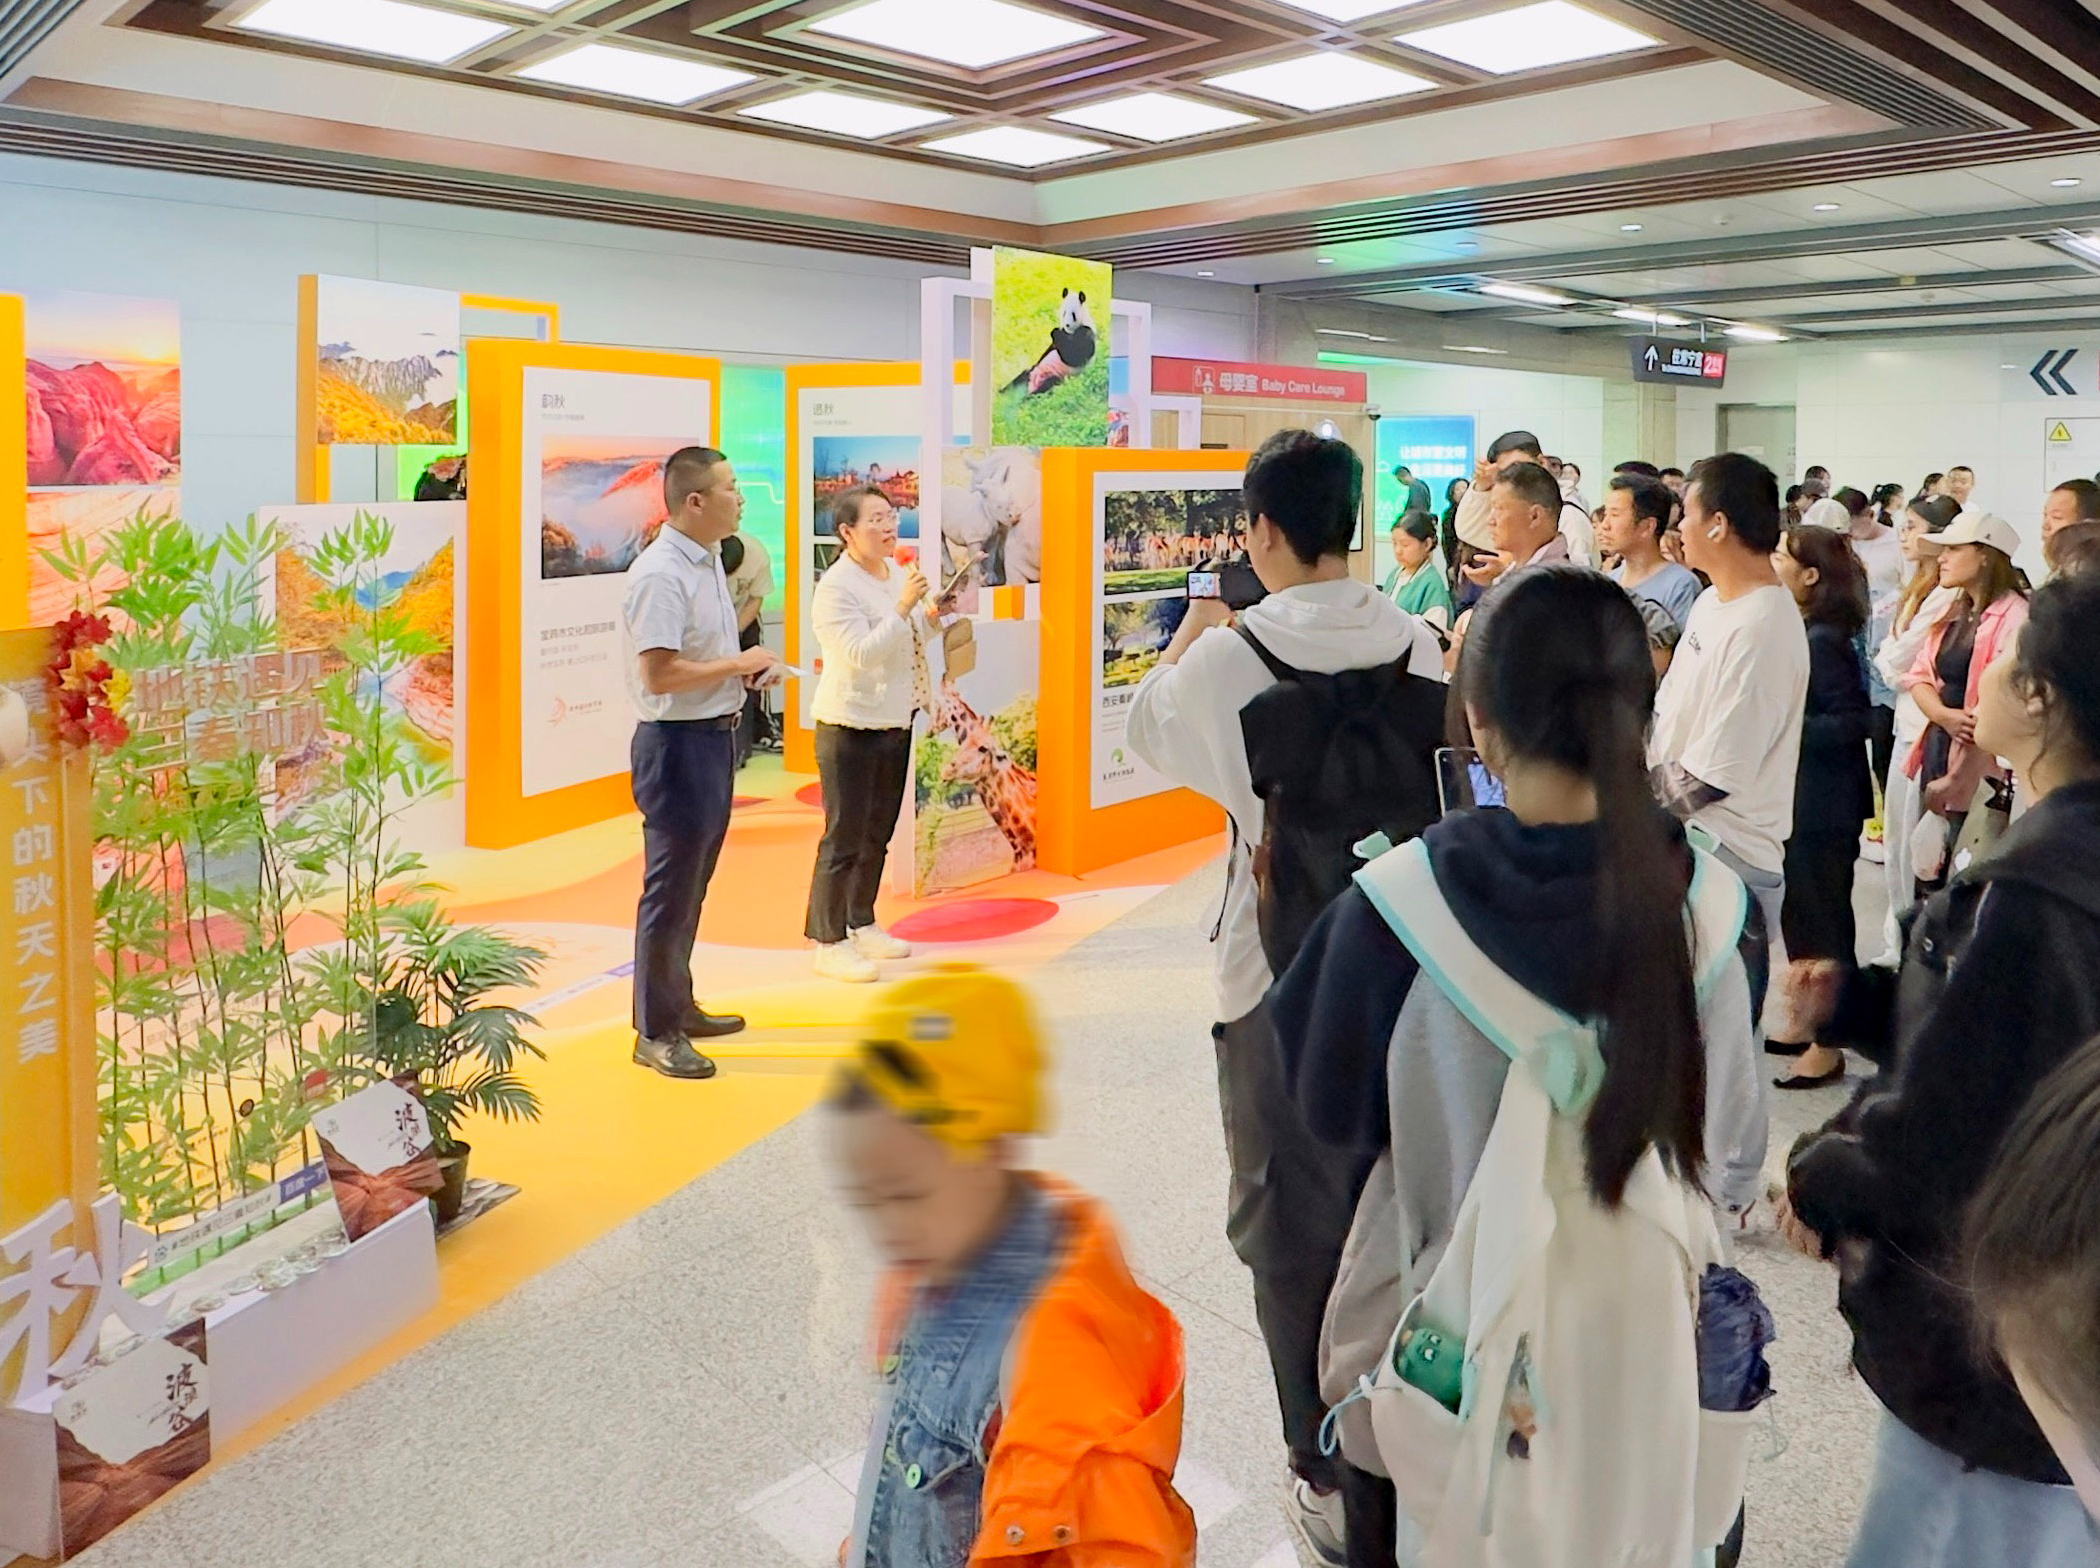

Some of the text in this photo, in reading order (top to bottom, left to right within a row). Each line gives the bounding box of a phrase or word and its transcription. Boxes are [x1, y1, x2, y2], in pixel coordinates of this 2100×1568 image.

[1219, 372, 1258, 393] 母婴室
[1262, 378, 1344, 398] Baby Care Lounge
[0, 1192, 176, 1400] 秋
